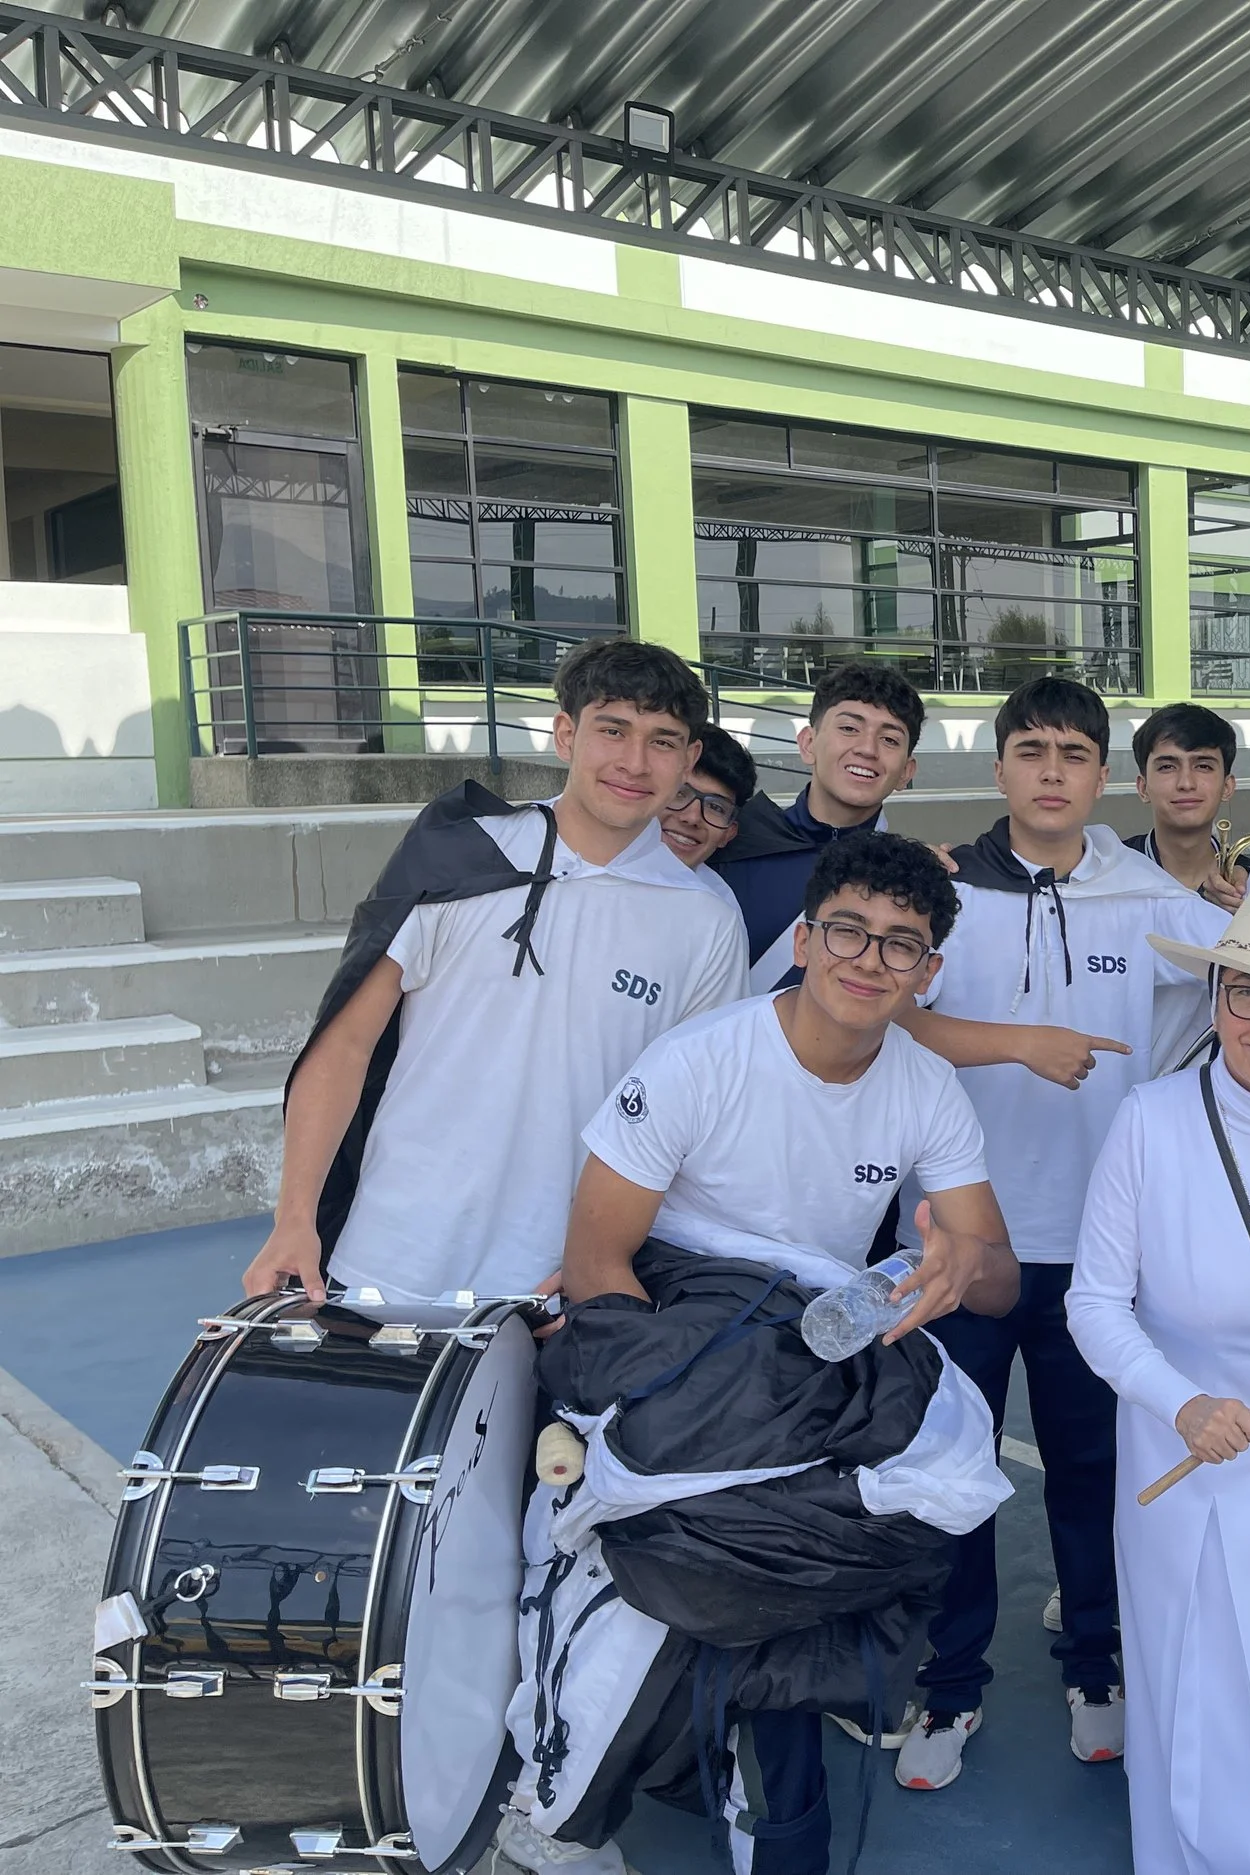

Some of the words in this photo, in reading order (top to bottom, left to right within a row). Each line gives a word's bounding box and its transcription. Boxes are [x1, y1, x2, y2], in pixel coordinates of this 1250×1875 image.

[1087, 955, 1127, 974] SDS
[611, 968, 662, 1006] SDS
[854, 1163, 898, 1185] SDS
